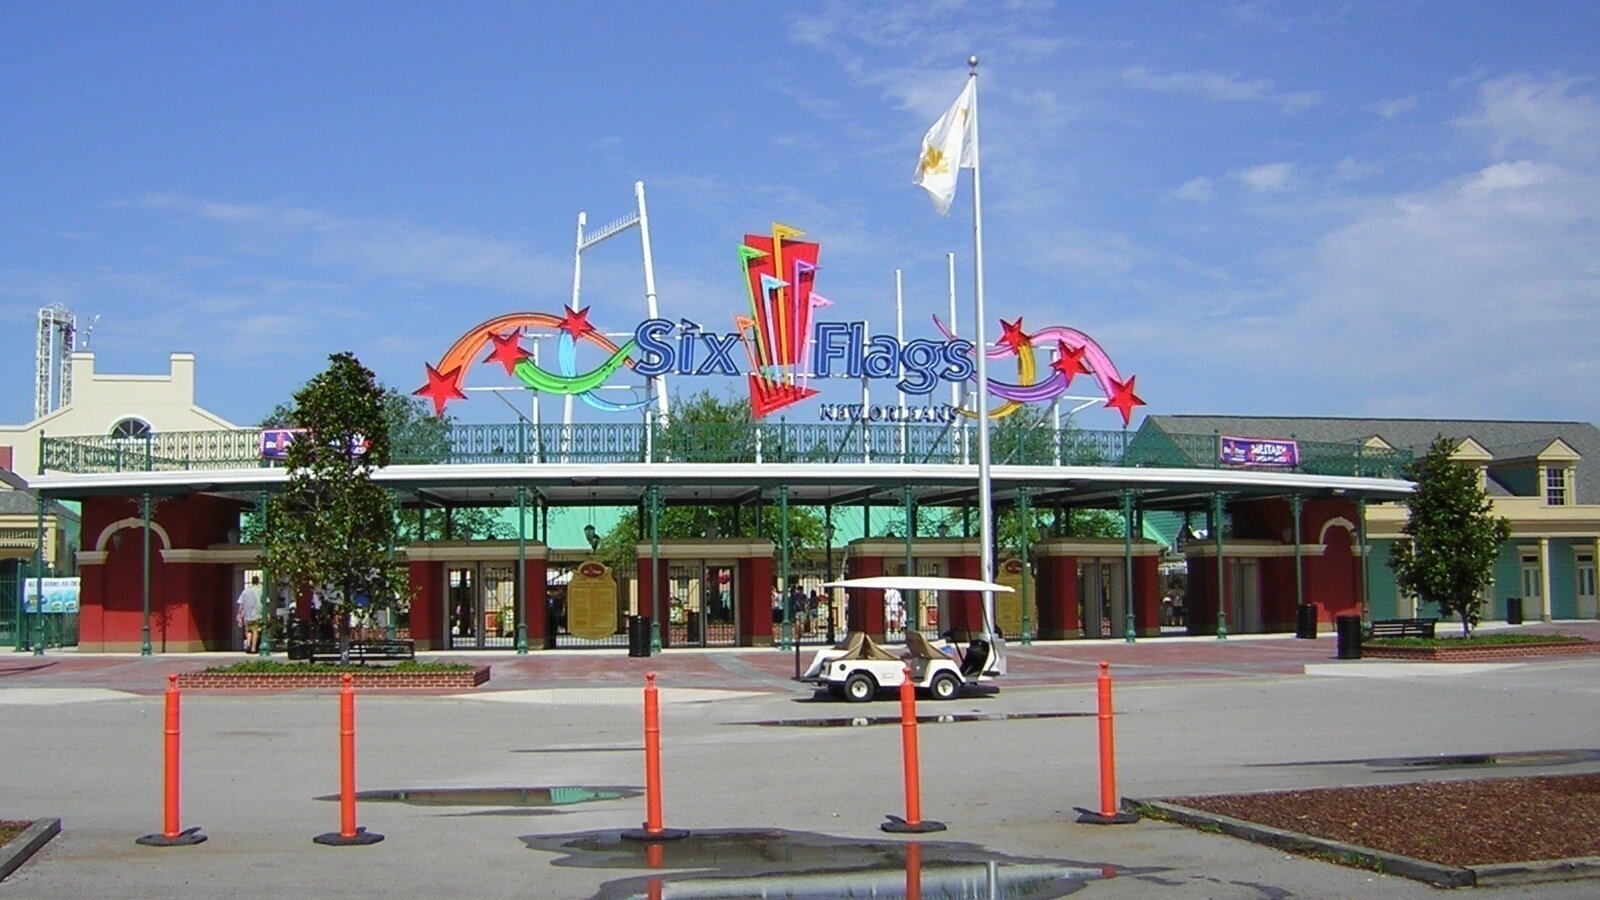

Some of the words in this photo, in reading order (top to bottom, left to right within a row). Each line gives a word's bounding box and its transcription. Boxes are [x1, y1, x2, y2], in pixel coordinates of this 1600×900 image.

[634, 318, 741, 377] Six
[812, 321, 976, 396] Flags
[820, 403, 865, 421] NEW
[868, 403, 958, 423] ORLEANS
